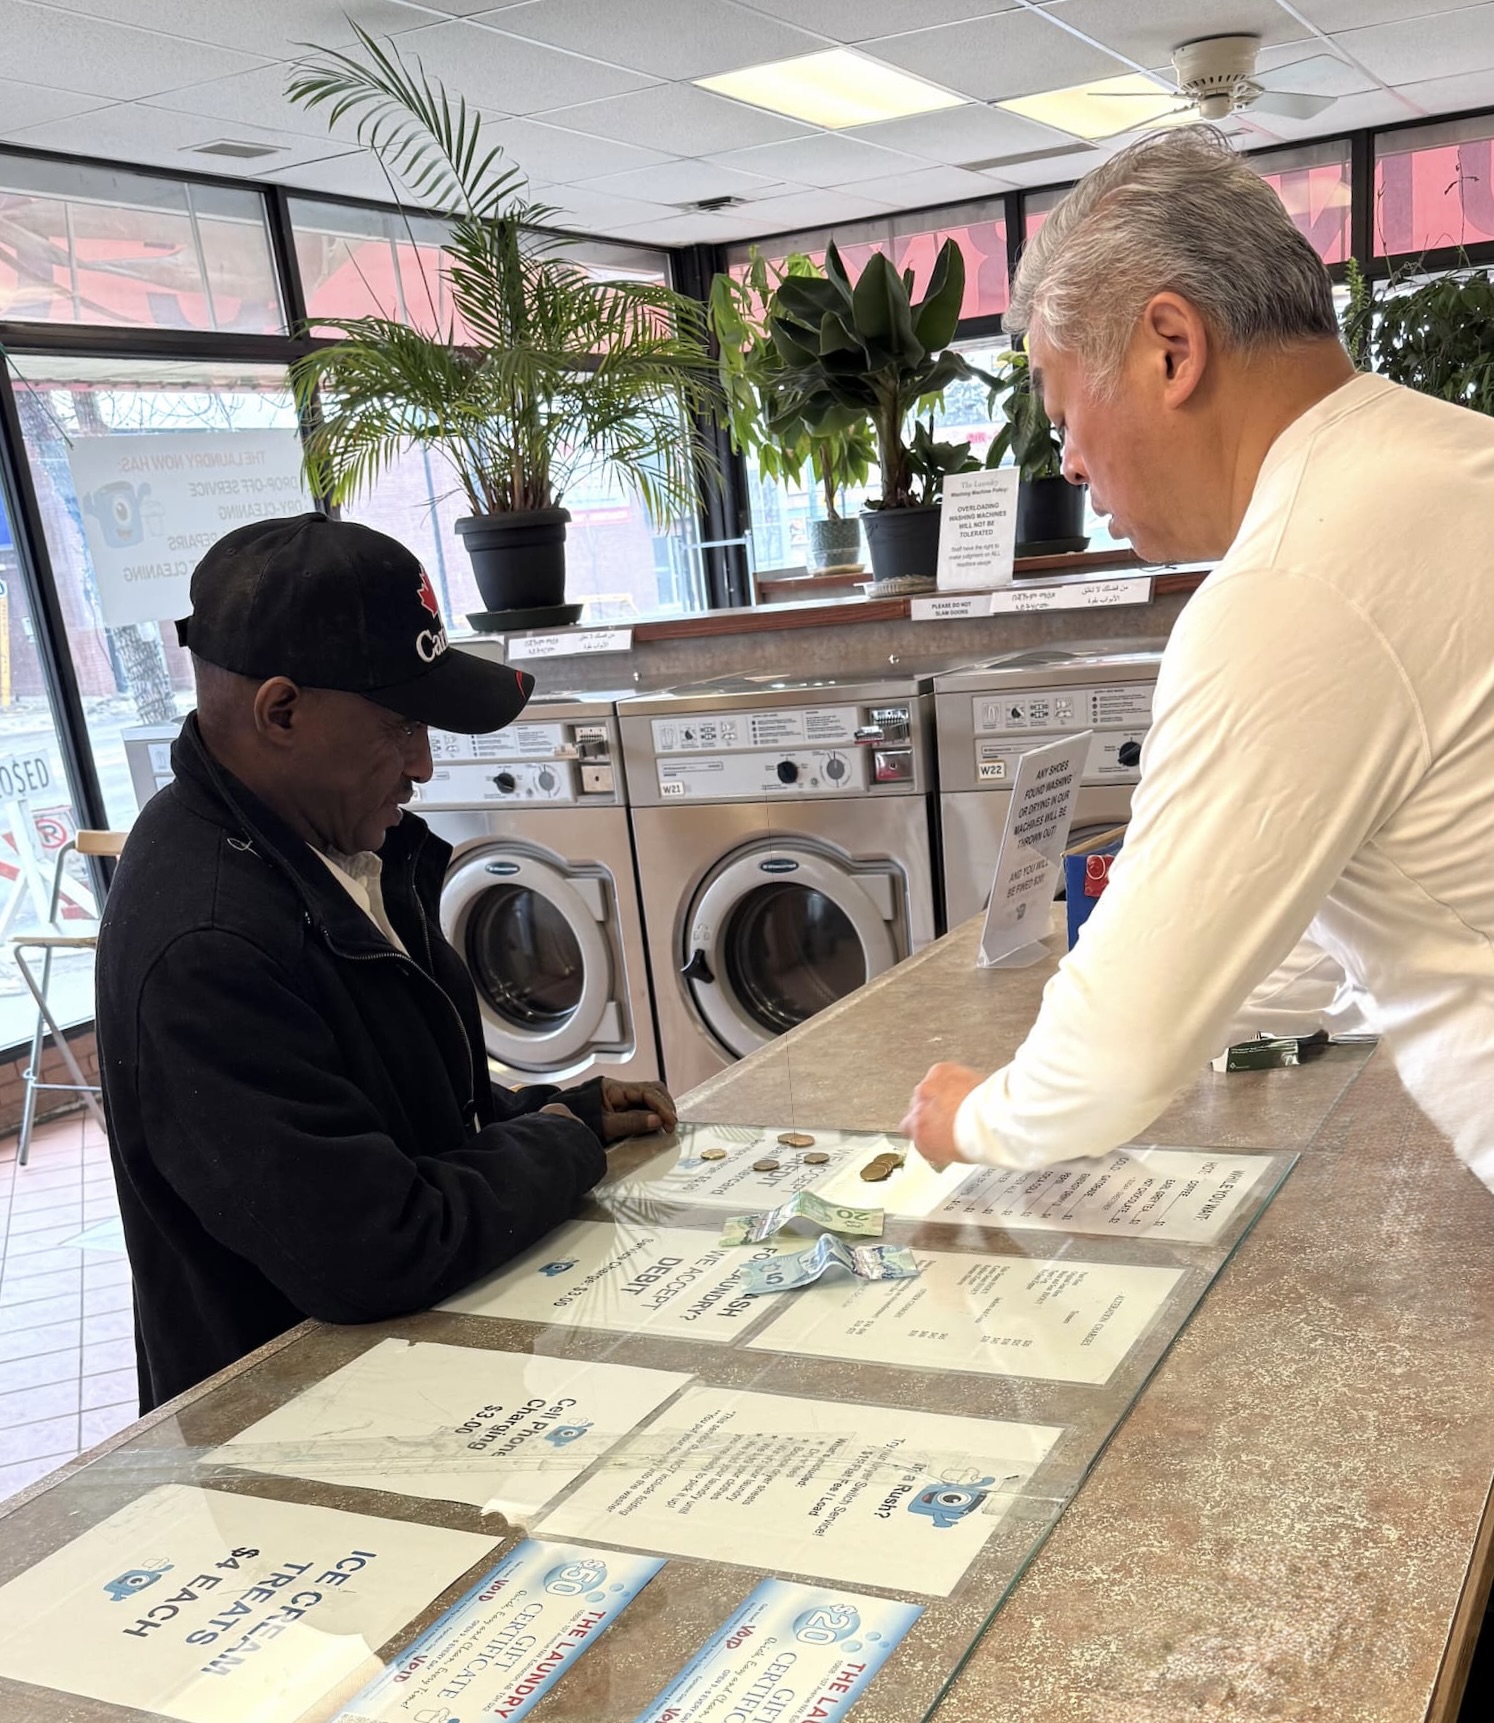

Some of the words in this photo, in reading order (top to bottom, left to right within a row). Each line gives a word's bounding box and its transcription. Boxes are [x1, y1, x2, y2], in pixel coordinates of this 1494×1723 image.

[949, 514, 975, 522] WASHING
[976, 510, 1006, 518] MACHINES
[957, 501, 999, 512] OVERLOADING
[959, 528, 993, 538] TOLERATED
[416, 629, 448, 662] Can
[0, 758, 49, 797] OSED
[980, 766, 1002, 774] W22
[1036, 768, 1049, 779] ANY
[1048, 760, 1069, 776] SHOES
[662, 785, 681, 794] W21
[1025, 784, 1045, 799] FOUND
[1046, 774, 1072, 791] WASHING
[1019, 806, 1028, 818] OR
[1028, 798, 1050, 814] DRYING
[1050, 795, 1057, 805] IN
[1057, 790, 1070, 803] OUR
[1014, 815, 1044, 835] MACHINES
[1044, 812, 1057, 823] WILL
[1058, 806, 1067, 817] BE
[1019, 832, 1042, 845] THROWN
[1009, 869, 1022, 883] AND
[1023, 864, 1035, 876] YOU
[1007, 886, 1016, 898] BE
[1159, 1179, 1175, 1190] EARL
[1219, 1170, 1243, 1188] WHILE
[1117, 1188, 1147, 1213] CHOCOLATE
[1208, 1190, 1229, 1203] YOU
[837, 1209, 868, 1221] 20
[1197, 1204, 1216, 1220] WAIT:
[617, 1239, 653, 1260] Service
[695, 1250, 727, 1265] WE
[749, 1247, 778, 1262] FO
[581, 1262, 622, 1285] Charge:
[622, 1257, 682, 1295] DEBIT
[766, 1273, 783, 1285] 5
[553, 1287, 588, 1307] $3.00
[642, 1267, 702, 1310] ACCEPT
[718, 1293, 758, 1317] ASH
[541, 1398, 577, 1419] Cell
[455, 1405, 503, 1434] $3.00
[468, 1399, 545, 1450] Charging
[492, 1421, 548, 1456] Phone
[886, 1438, 905, 1448] Try
[762, 1468, 781, 1484] dryer
[841, 1464, 861, 1477] Flat
[630, 1480, 645, 1490] the
[643, 1474, 669, 1494] include
[681, 1479, 699, 1492] pick
[690, 1478, 720, 1500] laundry
[710, 1478, 735, 1500] clothes
[726, 1479, 755, 1501] laundry
[829, 1479, 848, 1492] Fee
[840, 1481, 867, 1504] Switch
[608, 1491, 632, 1512] washer
[618, 1495, 647, 1516] folding
[666, 1498, 679, 1508] up!
[742, 1485, 766, 1505] sheets
[875, 1484, 912, 1518] Rush?
[678, 1500, 695, 1514] until
[808, 1497, 832, 1516] Load
[813, 1506, 846, 1536] Service!
[216, 1547, 259, 1569] $4
[315, 1551, 375, 1586] ICE
[546, 1559, 606, 1596] $50
[478, 1580, 509, 1602] VOID
[124, 1575, 221, 1637] EACH
[187, 1563, 311, 1644] TREATS
[483, 1611, 505, 1625] Easy
[568, 1611, 605, 1637] THE
[796, 1604, 857, 1645] $20
[202, 1591, 322, 1672] CREAM
[470, 1626, 486, 1640] and
[726, 1625, 755, 1649] VOID
[438, 1603, 543, 1698] CERTIFICATE
[444, 1641, 473, 1665] Clean,
[494, 1635, 536, 1672] GIFT
[394, 1655, 428, 1682] VOID
[421, 1667, 448, 1685] Every
[734, 1660, 757, 1676] Easy
[829, 1663, 866, 1693] THE
[495, 1642, 573, 1718] LAUNDRY
[723, 1677, 738, 1693] and
[400, 1687, 427, 1708] Time!
